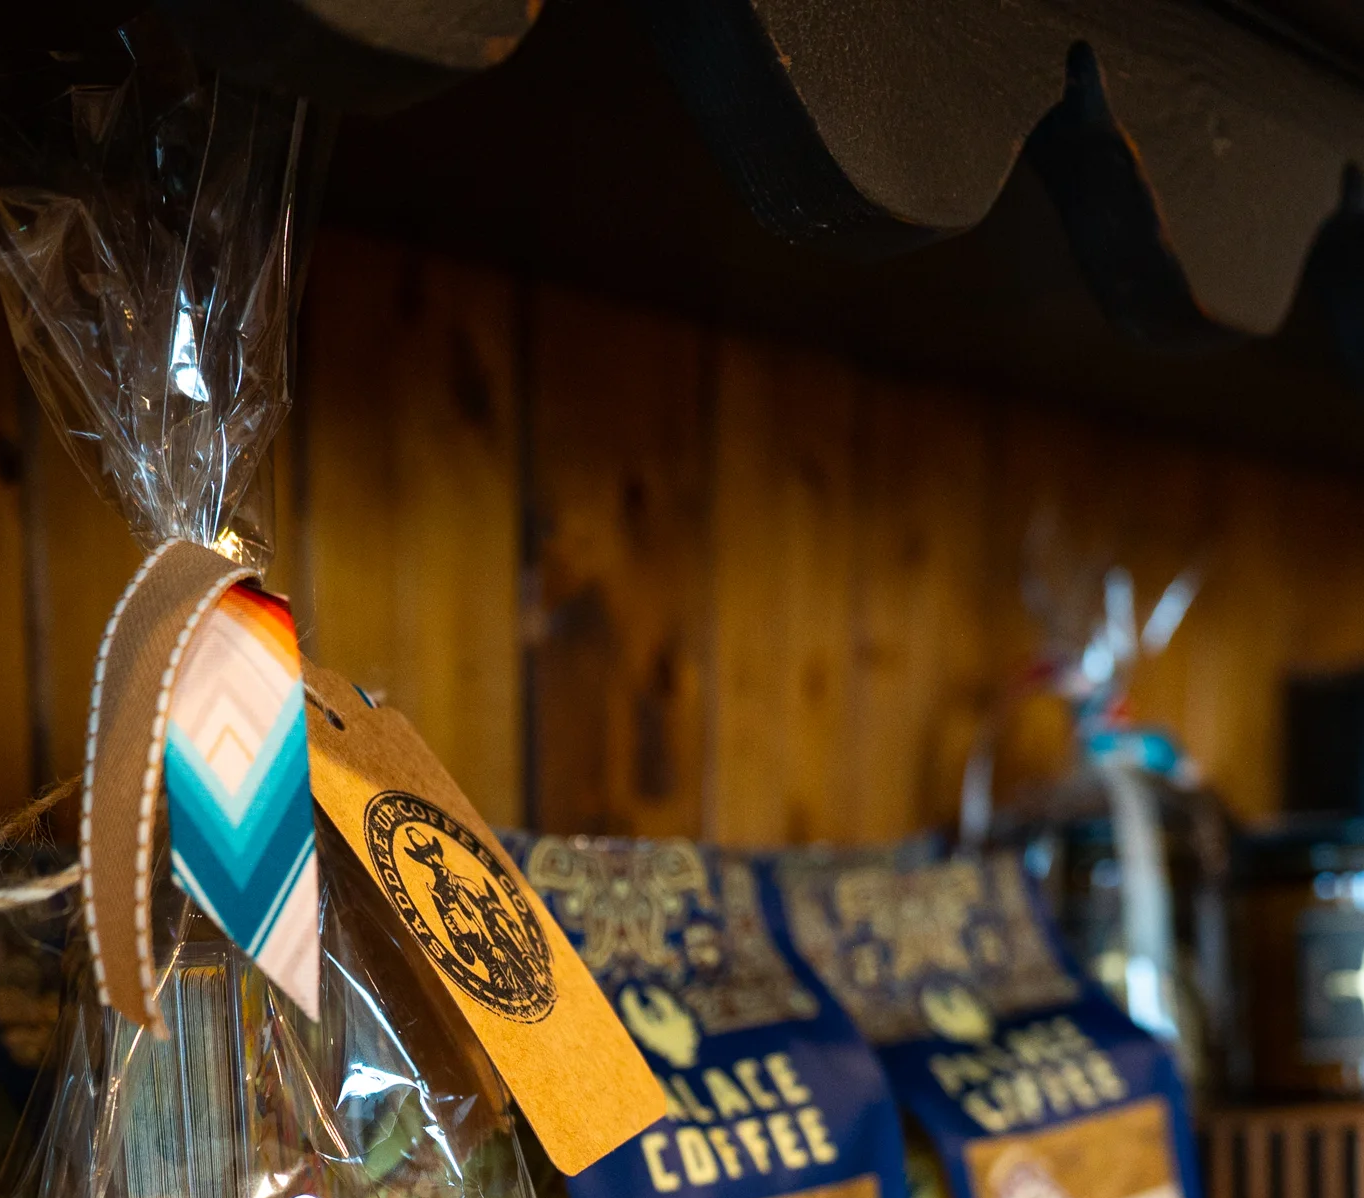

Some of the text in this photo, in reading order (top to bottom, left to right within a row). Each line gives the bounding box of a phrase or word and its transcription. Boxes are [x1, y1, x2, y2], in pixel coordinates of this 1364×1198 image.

[374, 804, 396, 831] UP
[397, 800, 493, 868] COFFEE
[371, 831, 448, 960] SADDLE
[640, 1106, 839, 1194] COFFEE
